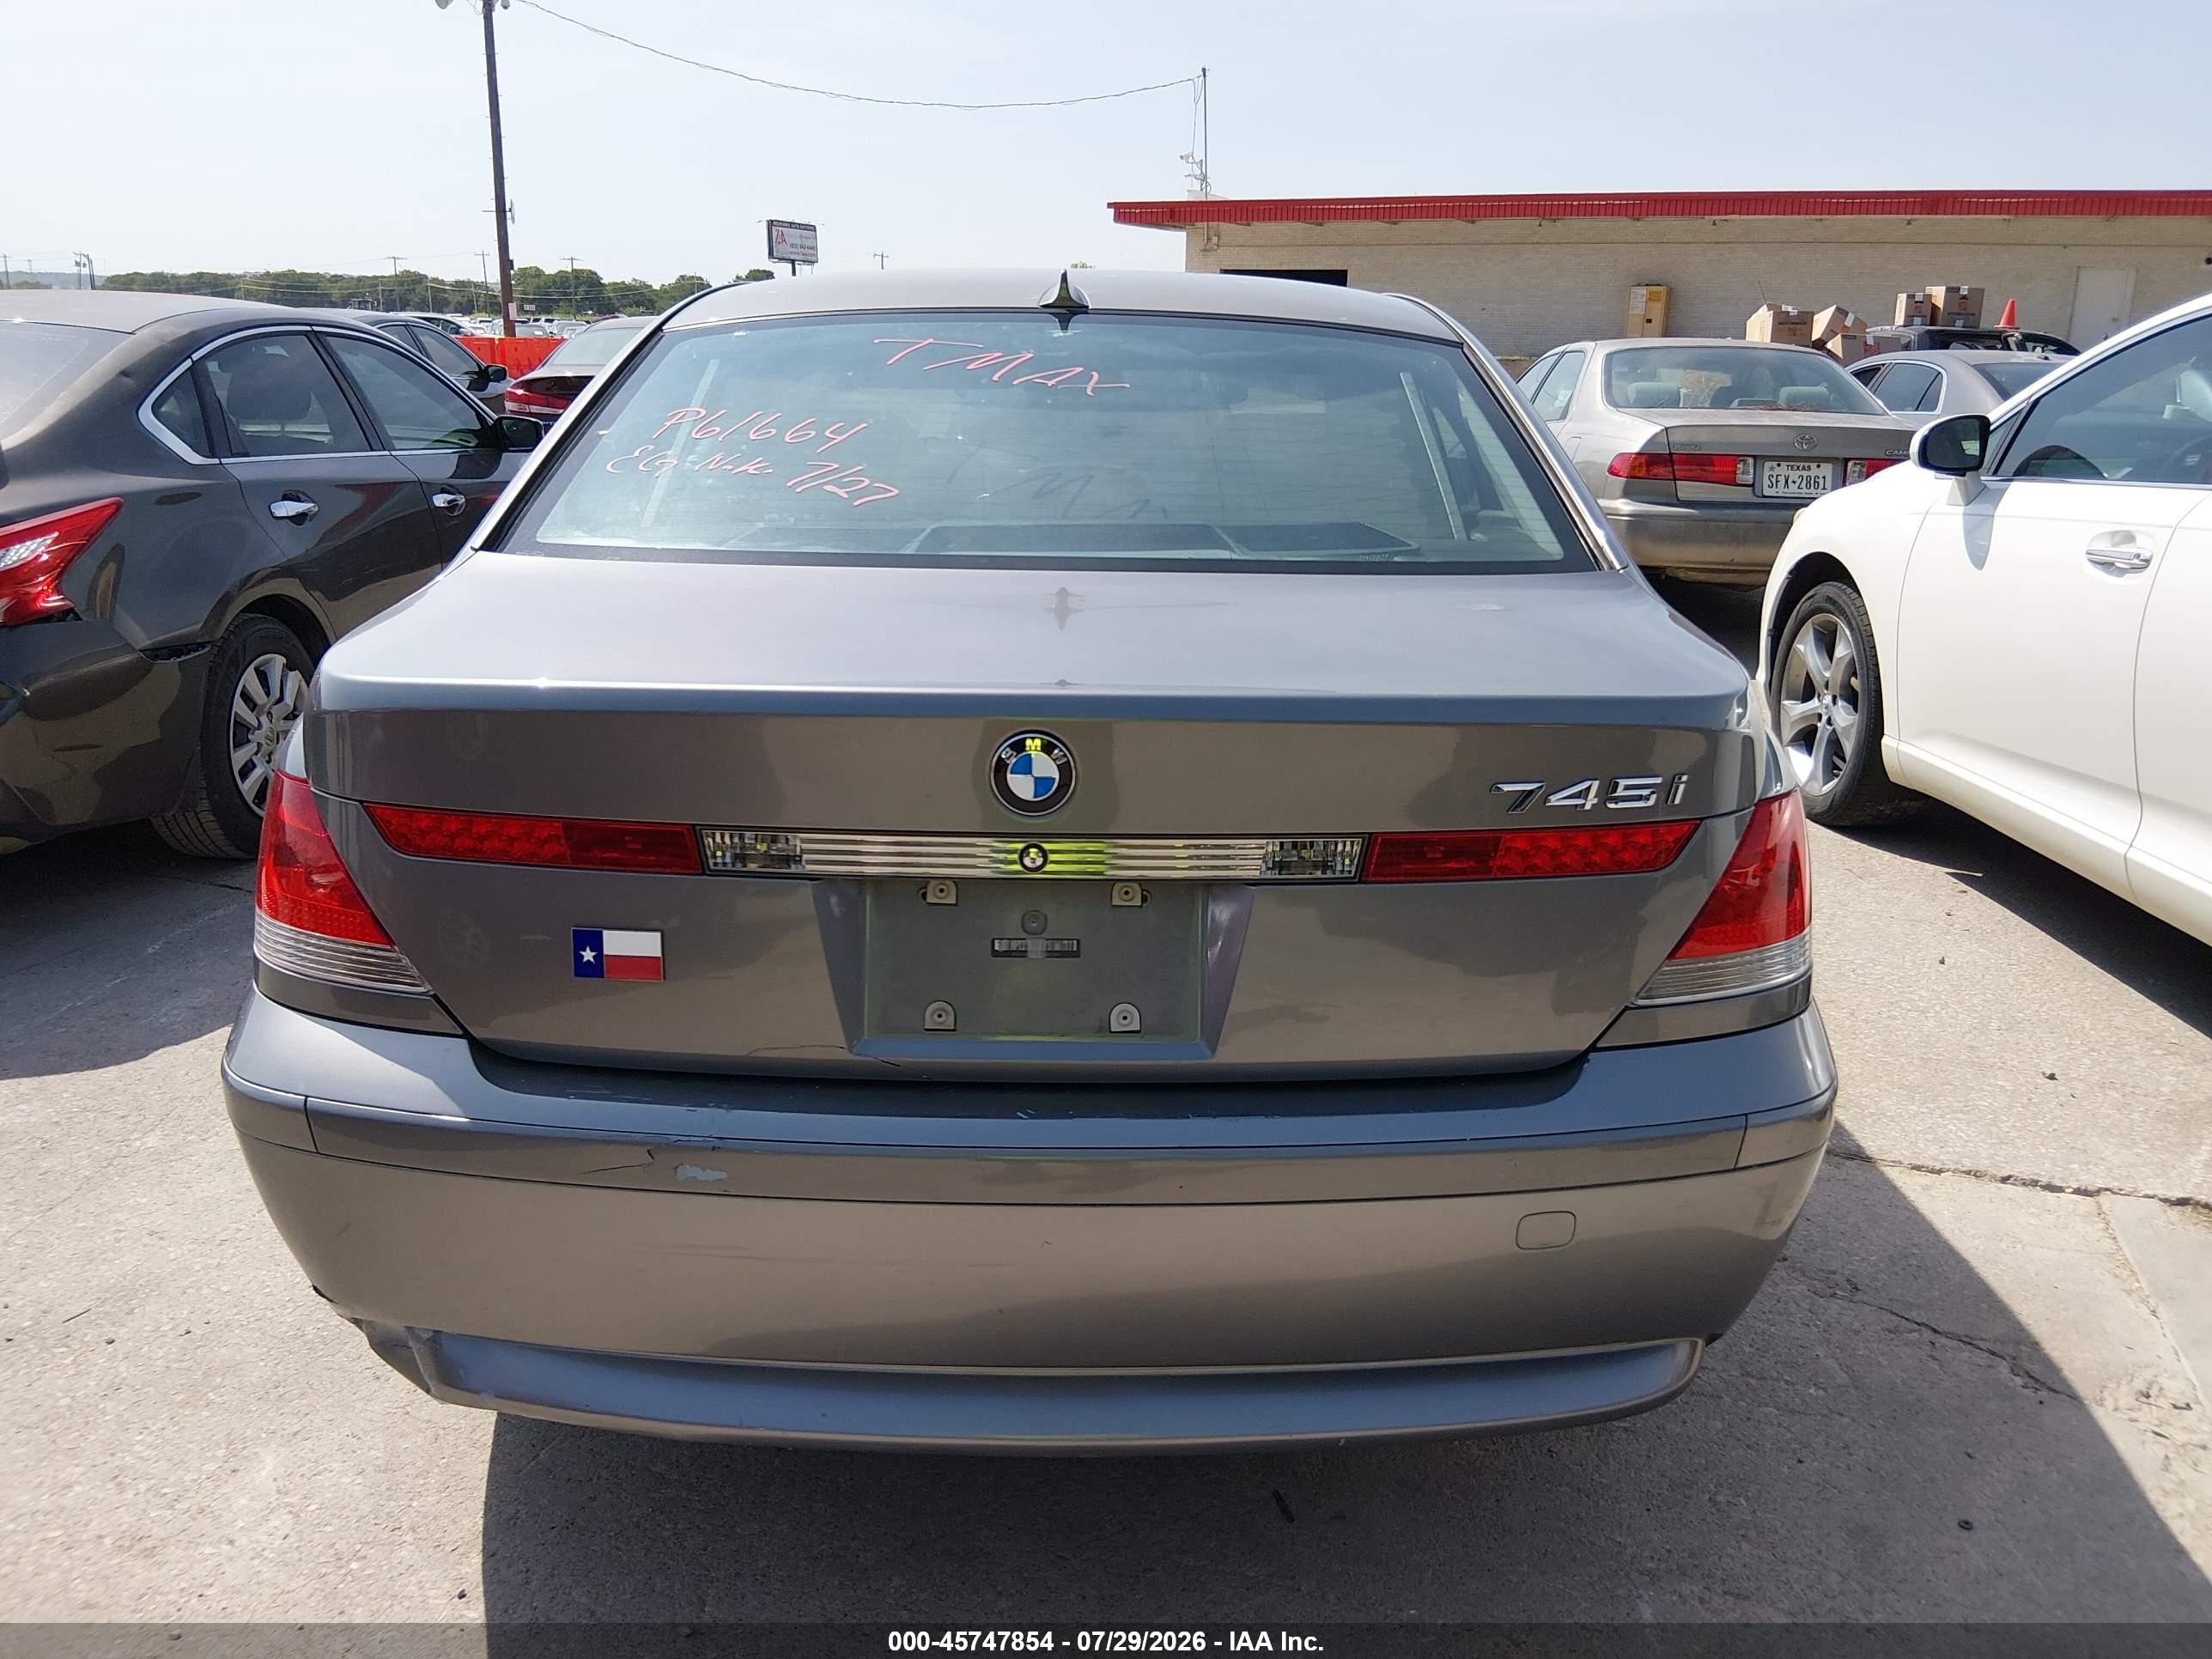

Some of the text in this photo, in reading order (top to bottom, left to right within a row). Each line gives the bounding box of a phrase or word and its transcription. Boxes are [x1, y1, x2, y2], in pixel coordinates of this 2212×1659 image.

[786, 461, 900, 507] 7/27
[1000, 738, 1068, 765] BMW
[1490, 774, 1689, 814] 745i
